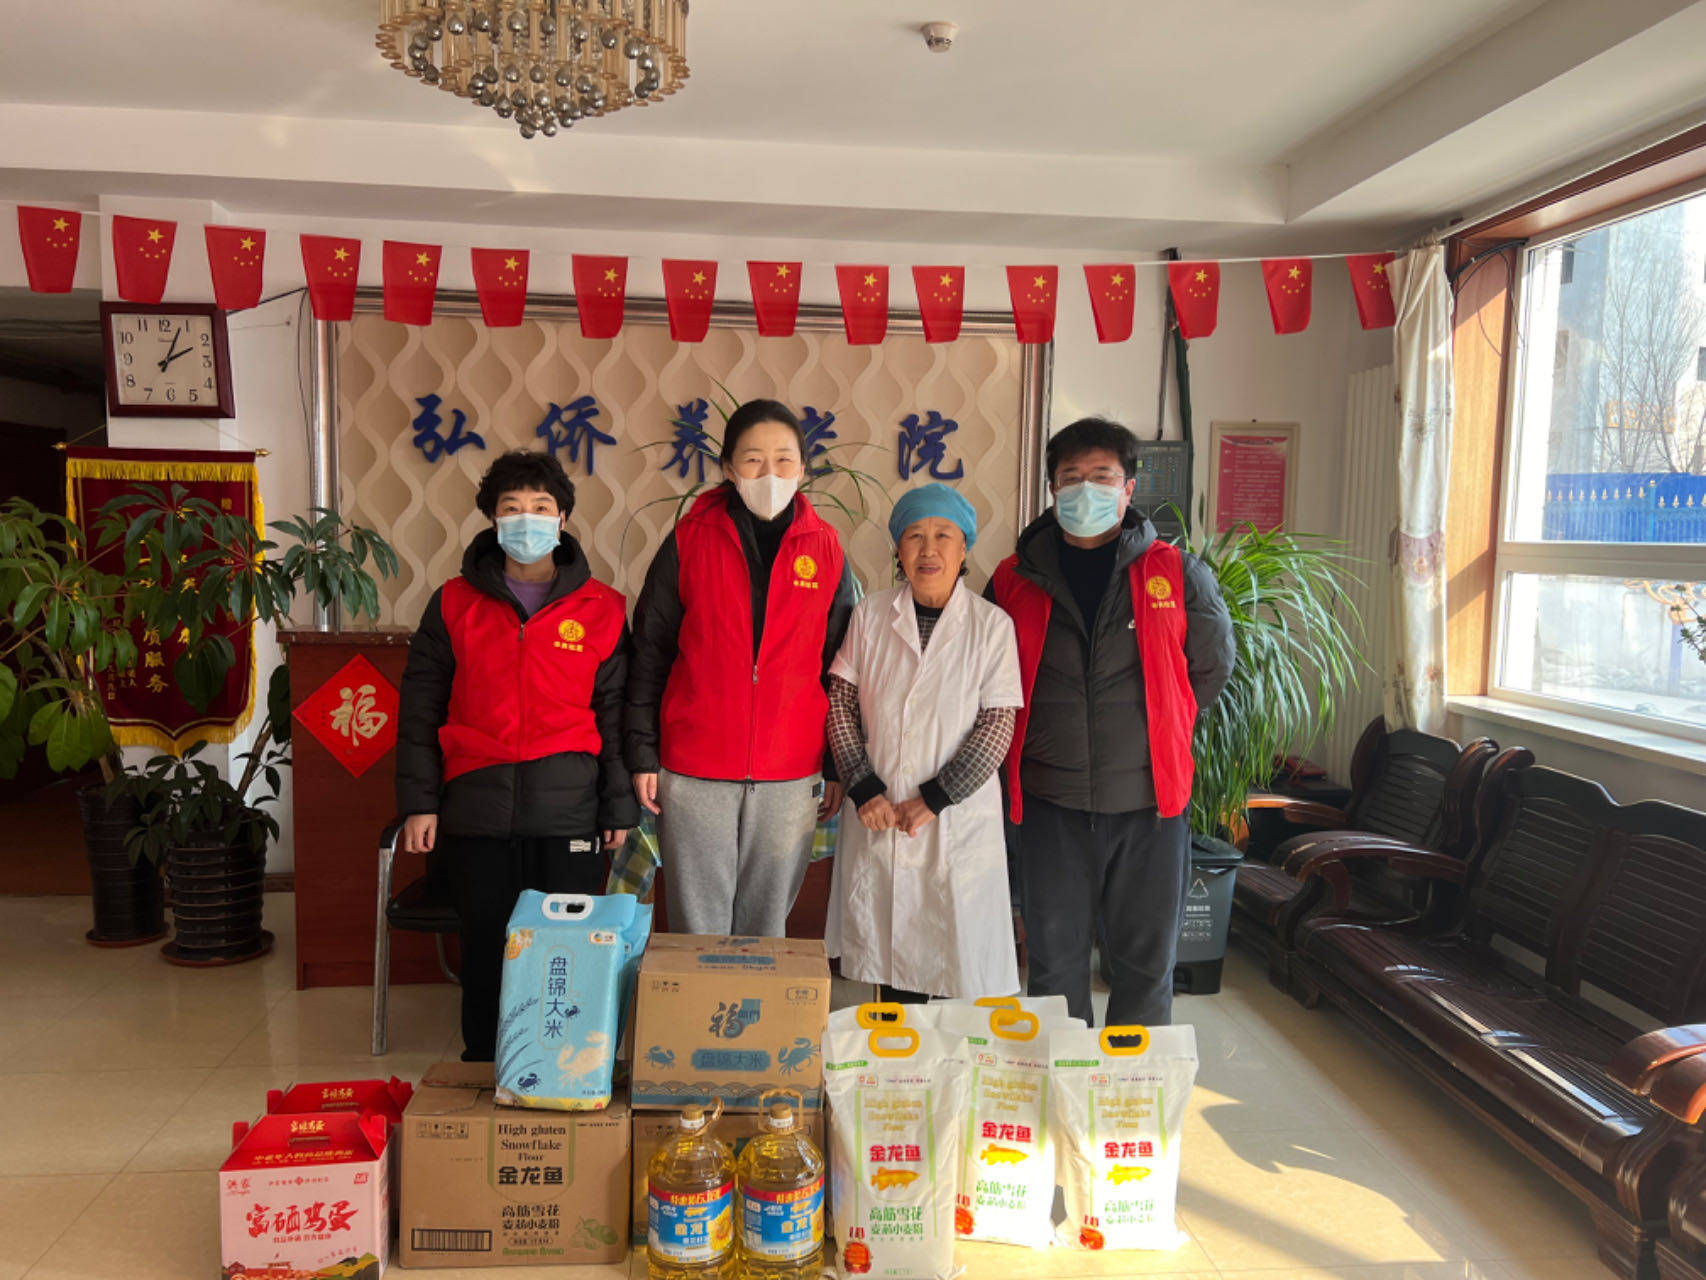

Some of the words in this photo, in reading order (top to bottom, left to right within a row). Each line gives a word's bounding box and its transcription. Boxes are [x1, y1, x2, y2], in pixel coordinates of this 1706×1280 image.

[138, 319, 148, 333] 11
[159, 319, 172, 333] 12
[121, 331, 134, 345] 10
[200, 333, 210, 347] 2
[123, 352, 133, 366] 9
[202, 355, 212, 369] 3
[126, 374, 136, 388] 8
[203, 376, 213, 390] 4
[144, 387, 153, 401] 7
[166, 387, 176, 402] 6
[188, 388, 198, 402] 5
[329, 684, 388, 747] 福
[544, 956, 568, 1039] 盘锦大米
[498, 1124, 527, 1137] High
[531, 1125, 566, 1138] gluten
[981, 1121, 1032, 1143] 金龙鱼
[869, 1144, 922, 1162] 金龙鱼
[1104, 1141, 1154, 1158] 金龙鱼
[518, 1153, 544, 1161] Flour
[498, 1166, 564, 1185] 金龙鱼
[246, 1200, 359, 1238] 富硒鸡蛋
